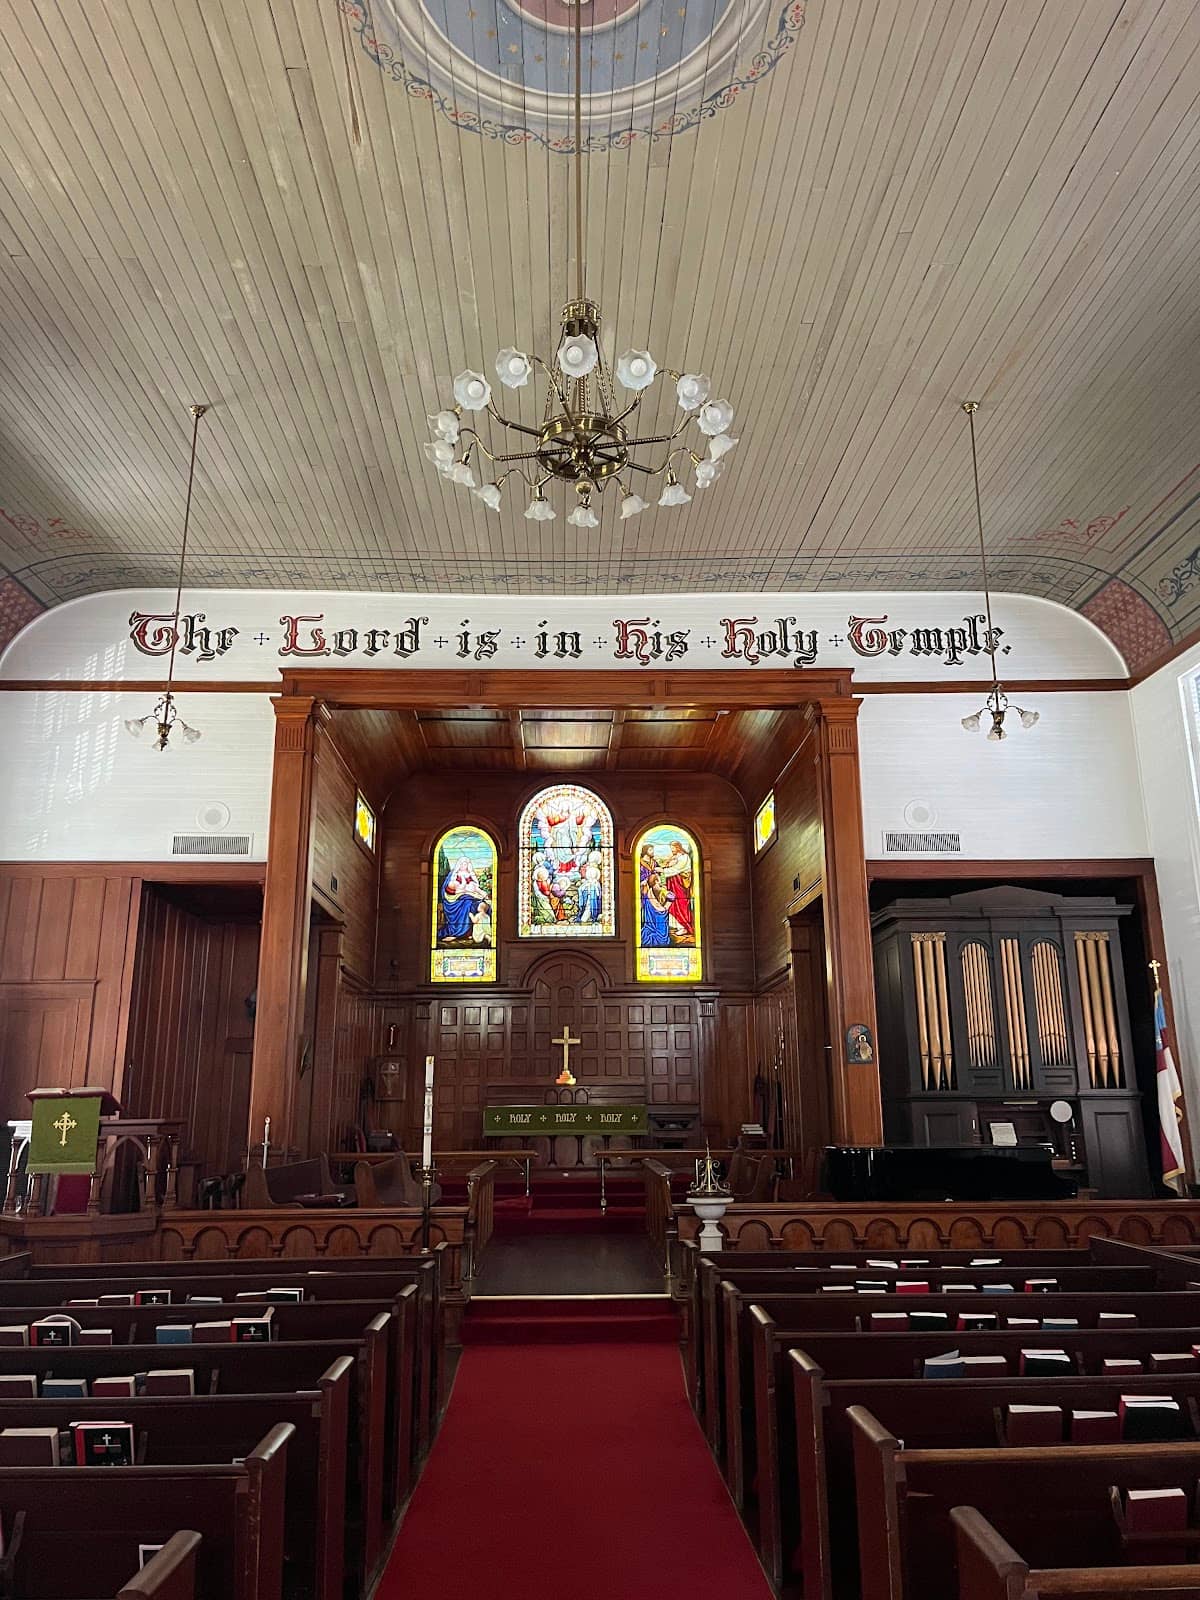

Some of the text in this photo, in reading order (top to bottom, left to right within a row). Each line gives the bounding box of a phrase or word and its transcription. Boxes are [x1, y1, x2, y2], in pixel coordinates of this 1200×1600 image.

[129, 611, 1012, 669] The Lord is in His Holy Temple.
